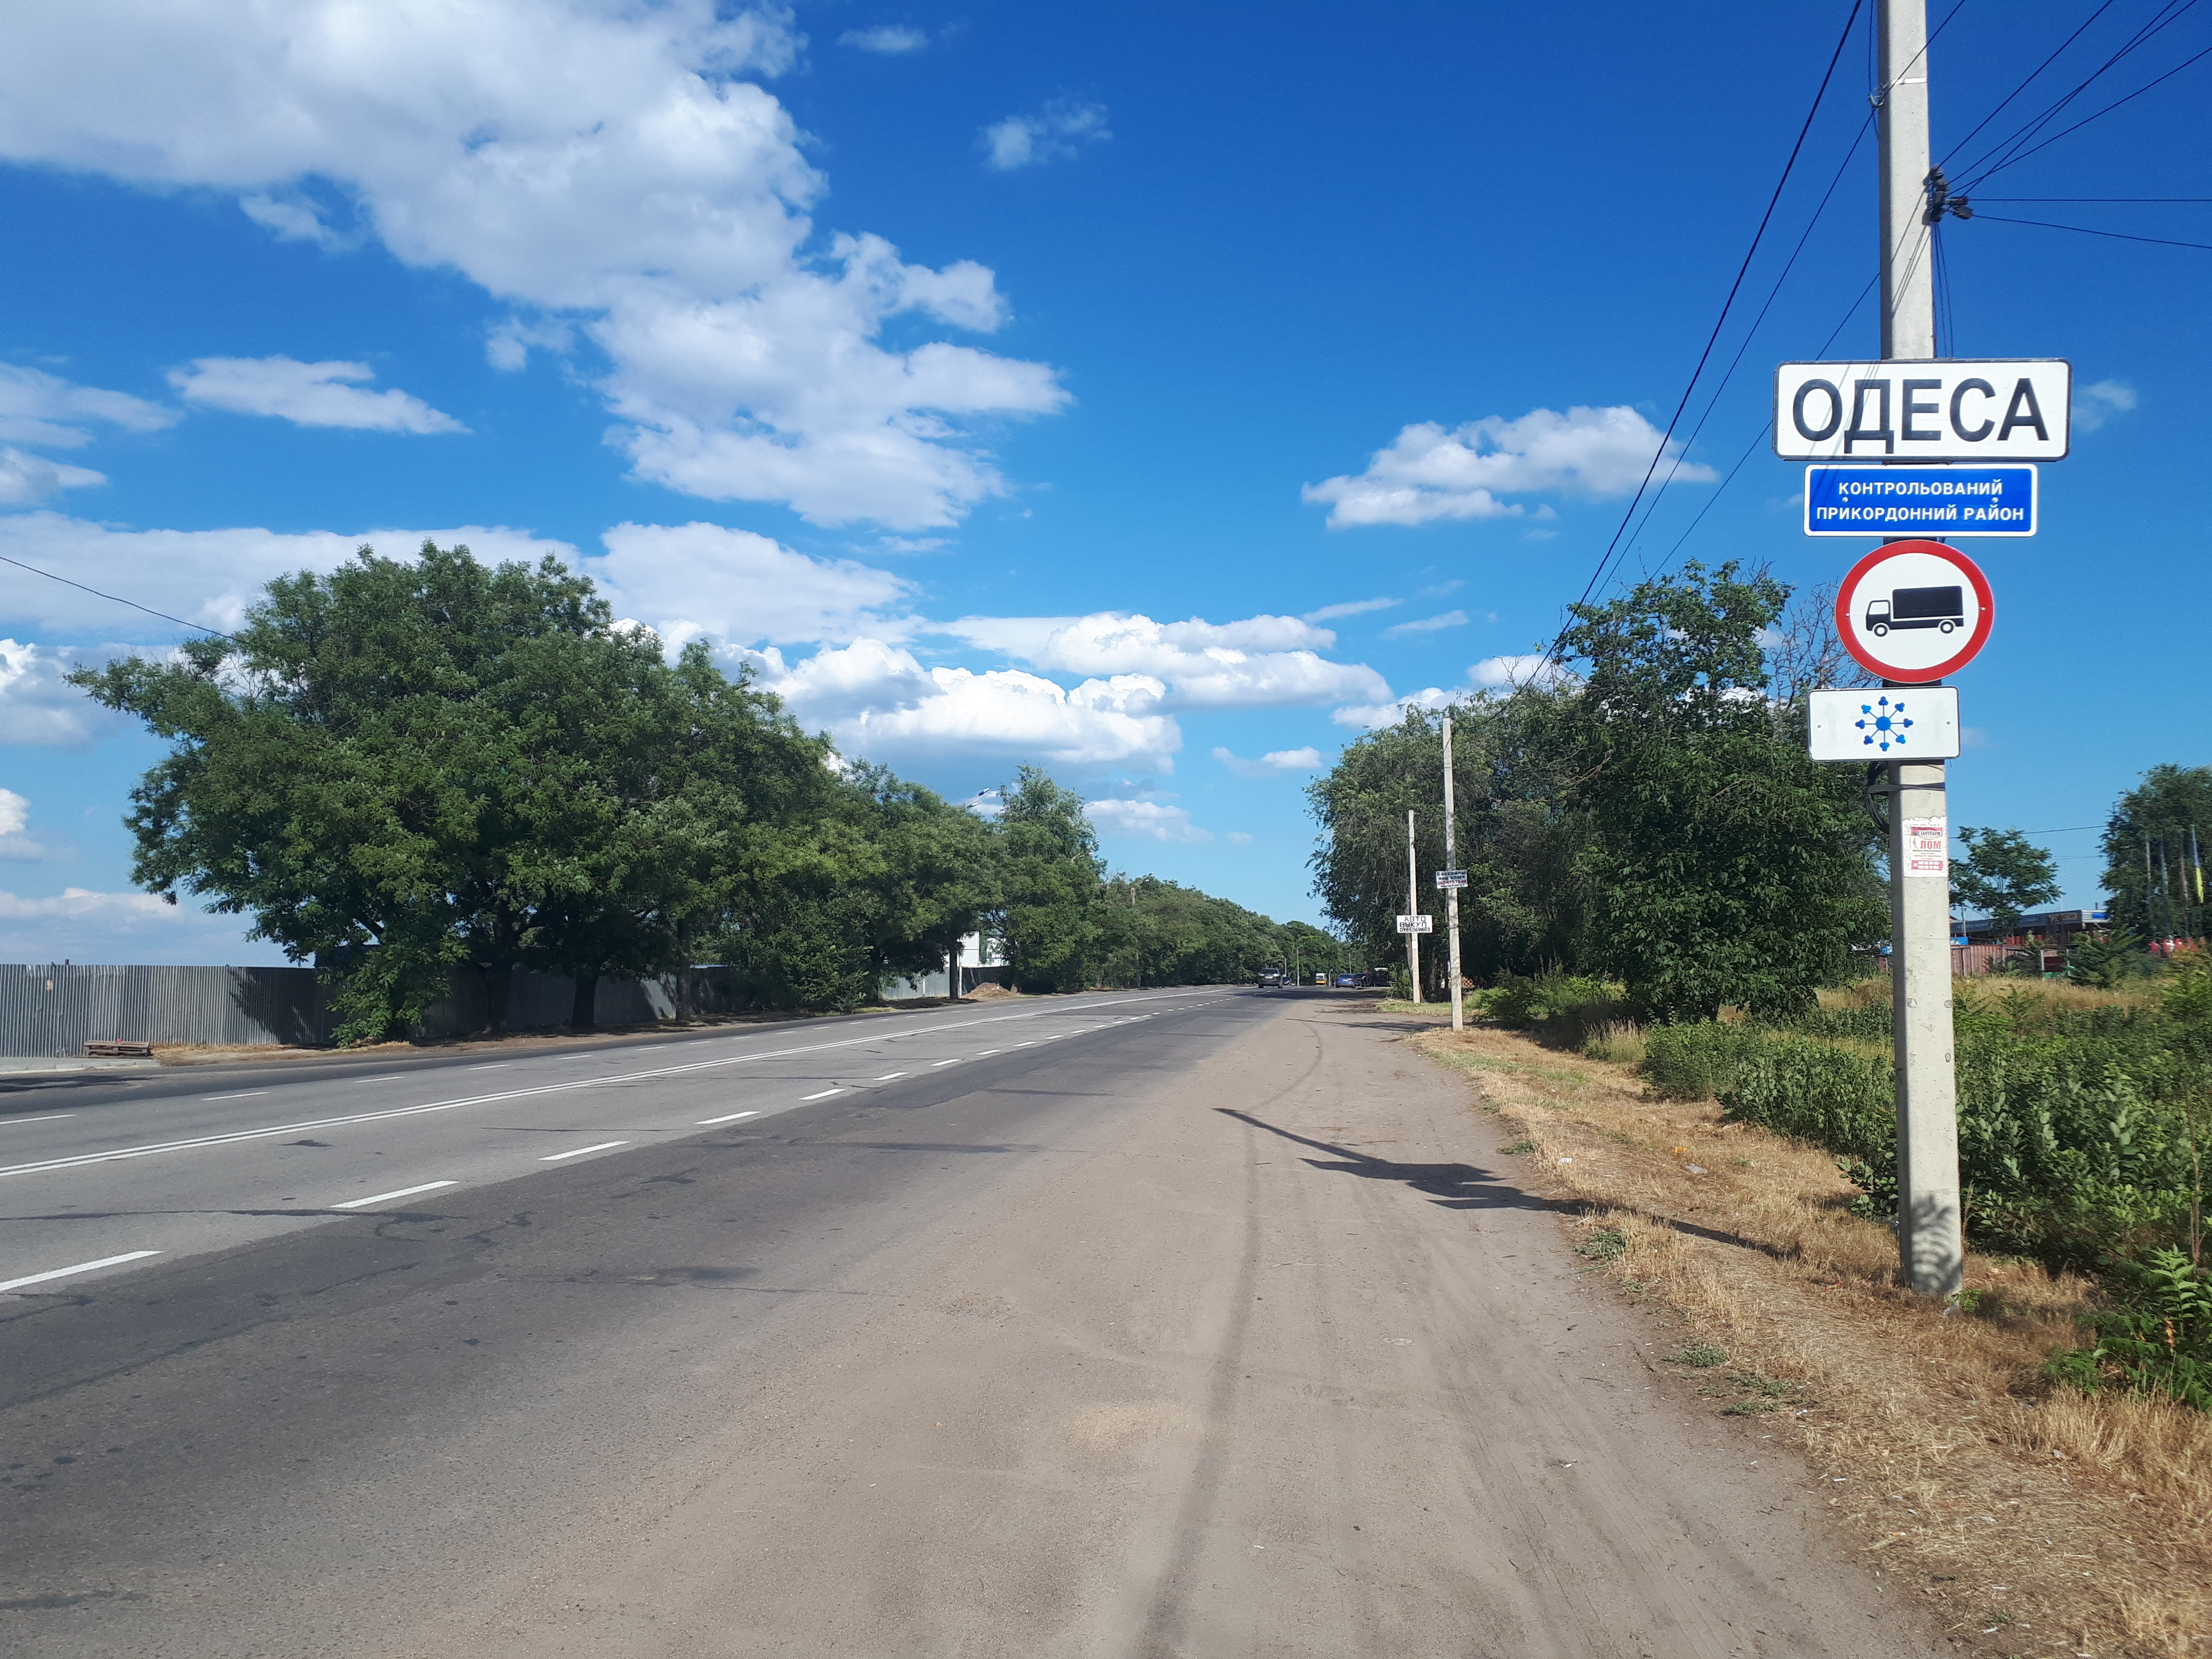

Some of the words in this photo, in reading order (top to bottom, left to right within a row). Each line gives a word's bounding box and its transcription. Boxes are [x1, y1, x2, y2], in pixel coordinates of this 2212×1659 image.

[1792, 378, 2050, 454] ОДЕСА
[1839, 479, 2003, 496] КОНТРОЛЬОВАНИЙ
[1817, 505, 1957, 522] ПРИКОРДОННИЙ
[1964, 502, 2024, 521] РАЙОН
[1920, 841, 1941, 849] ЛОМ
